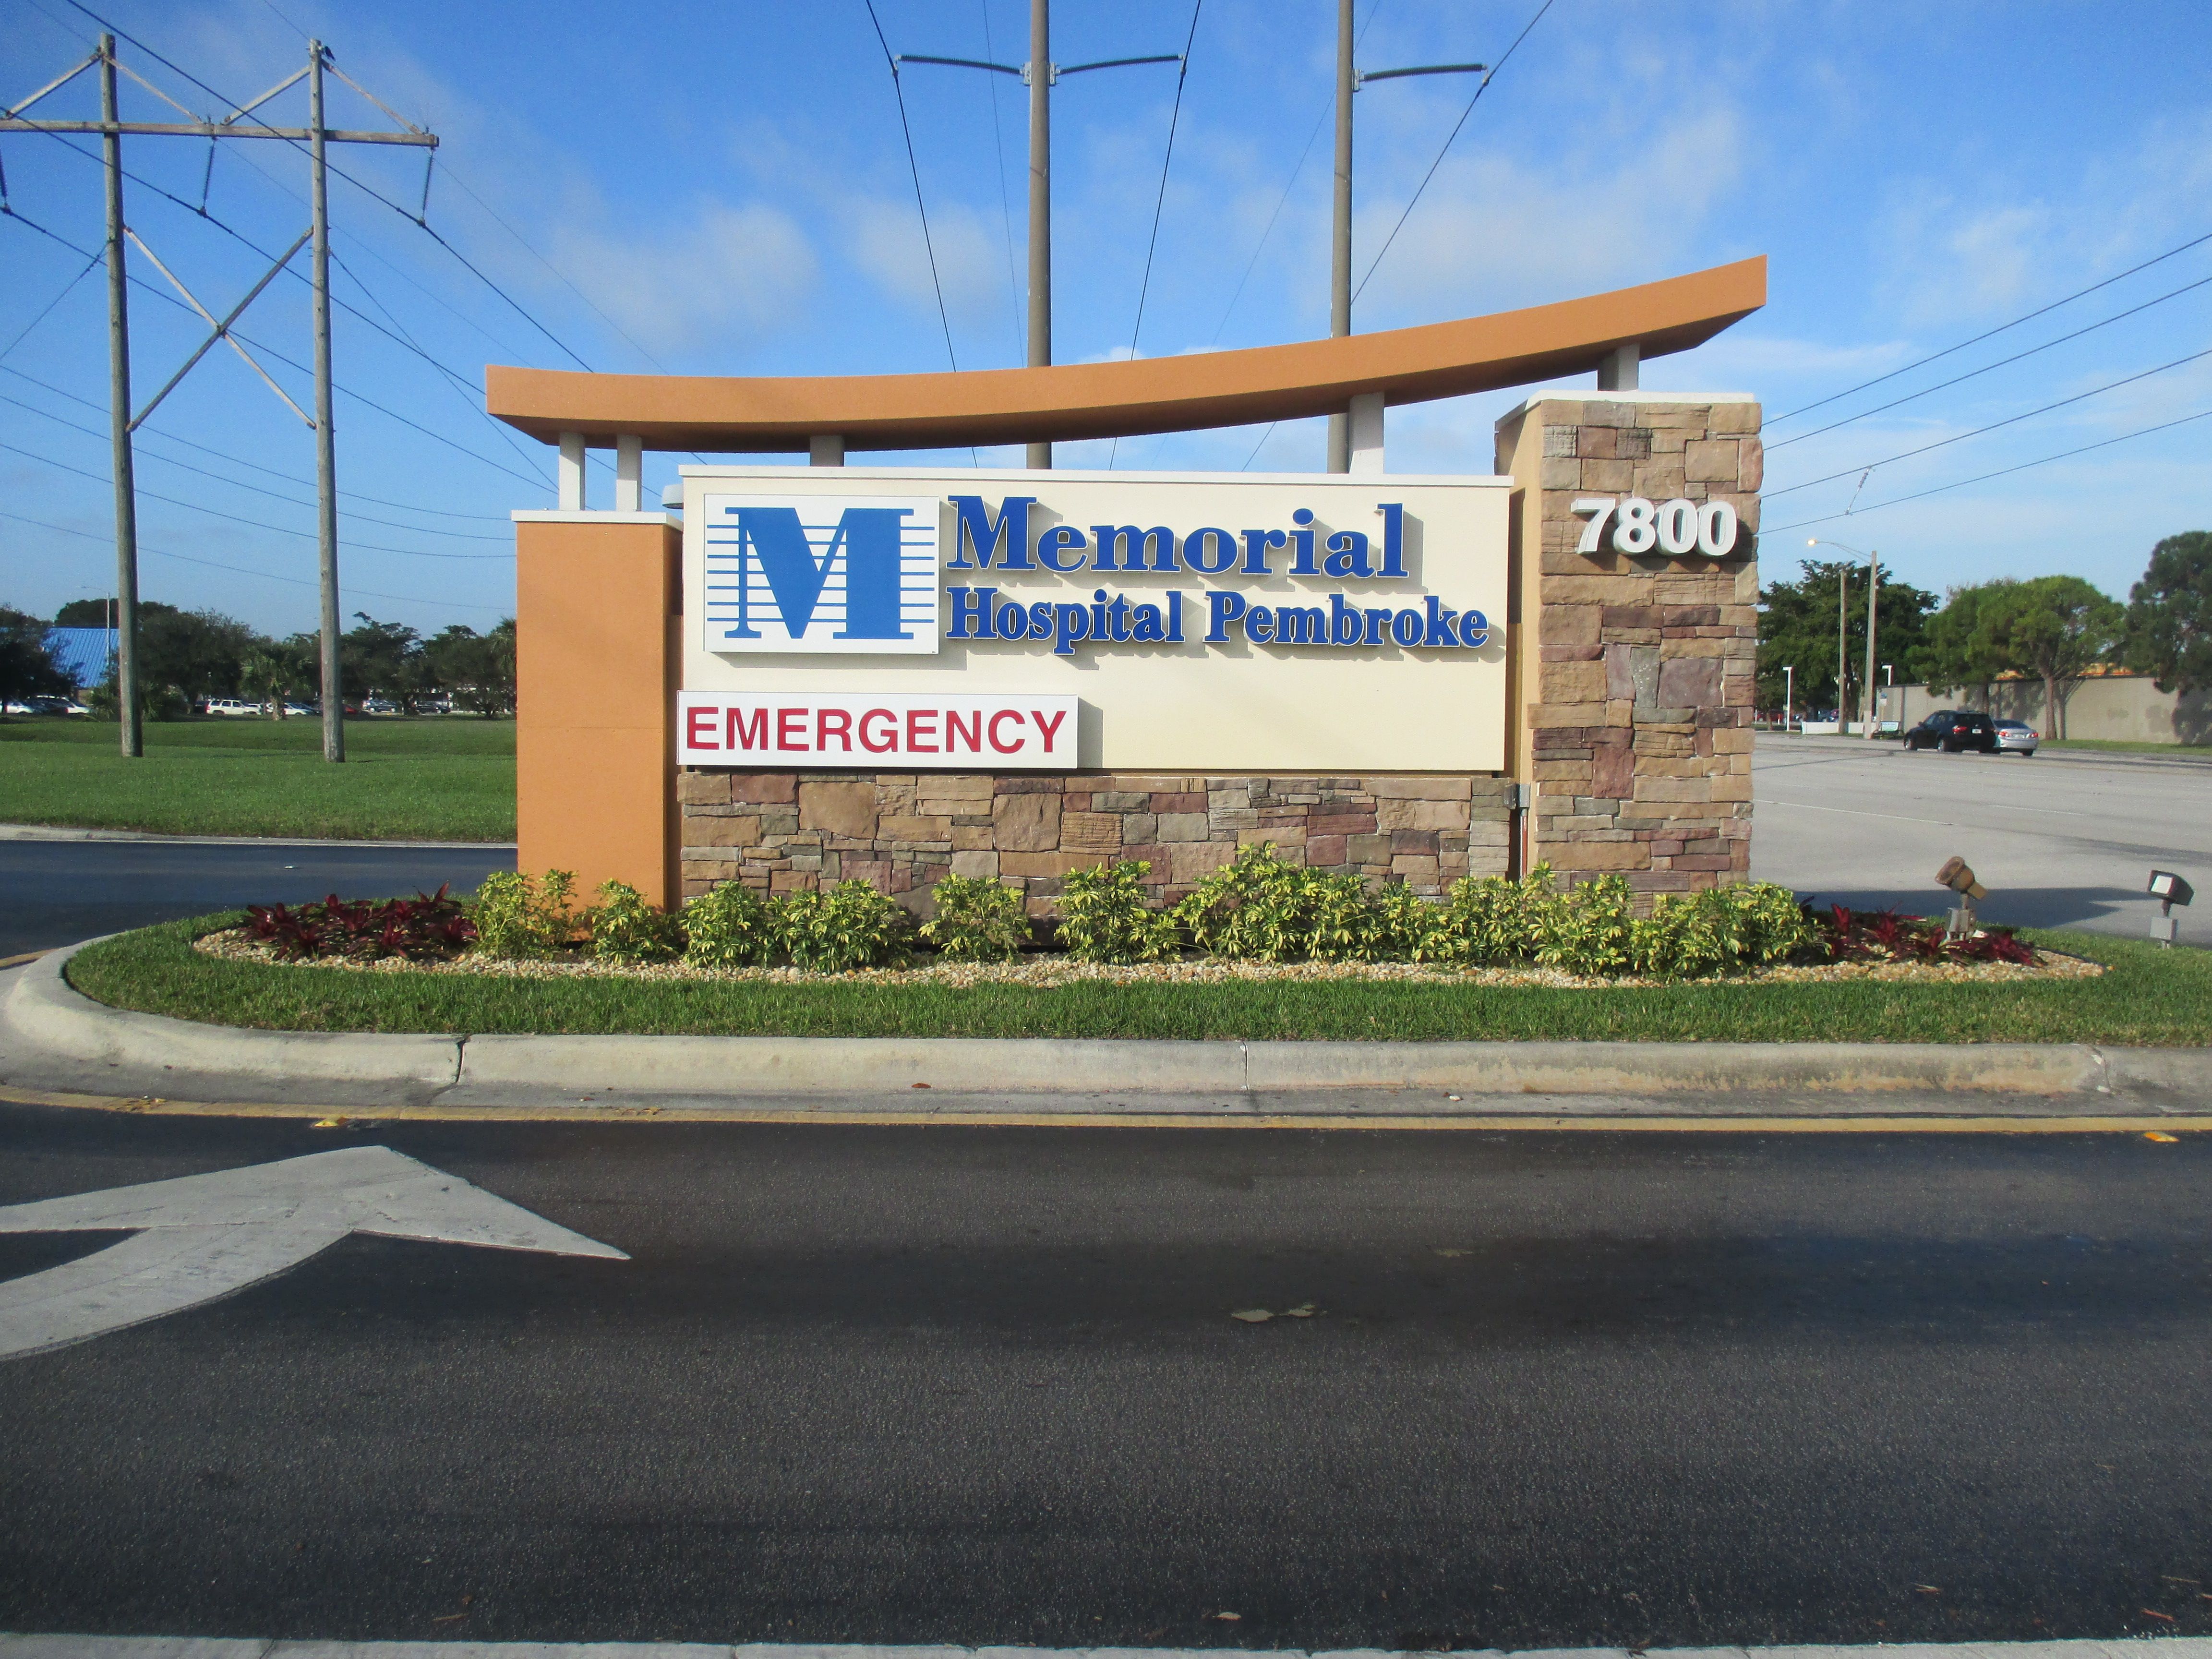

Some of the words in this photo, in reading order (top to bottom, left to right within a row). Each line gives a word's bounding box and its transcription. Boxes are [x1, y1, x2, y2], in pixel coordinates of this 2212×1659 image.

[946, 495, 1409, 579] Memorial
[1570, 497, 1737, 556] 7800
[724, 507, 914, 639] M
[946, 587, 1185, 654] Hospital
[1205, 590, 1489, 647] Pembroke
[687, 706, 1067, 754] EMERGENCY
